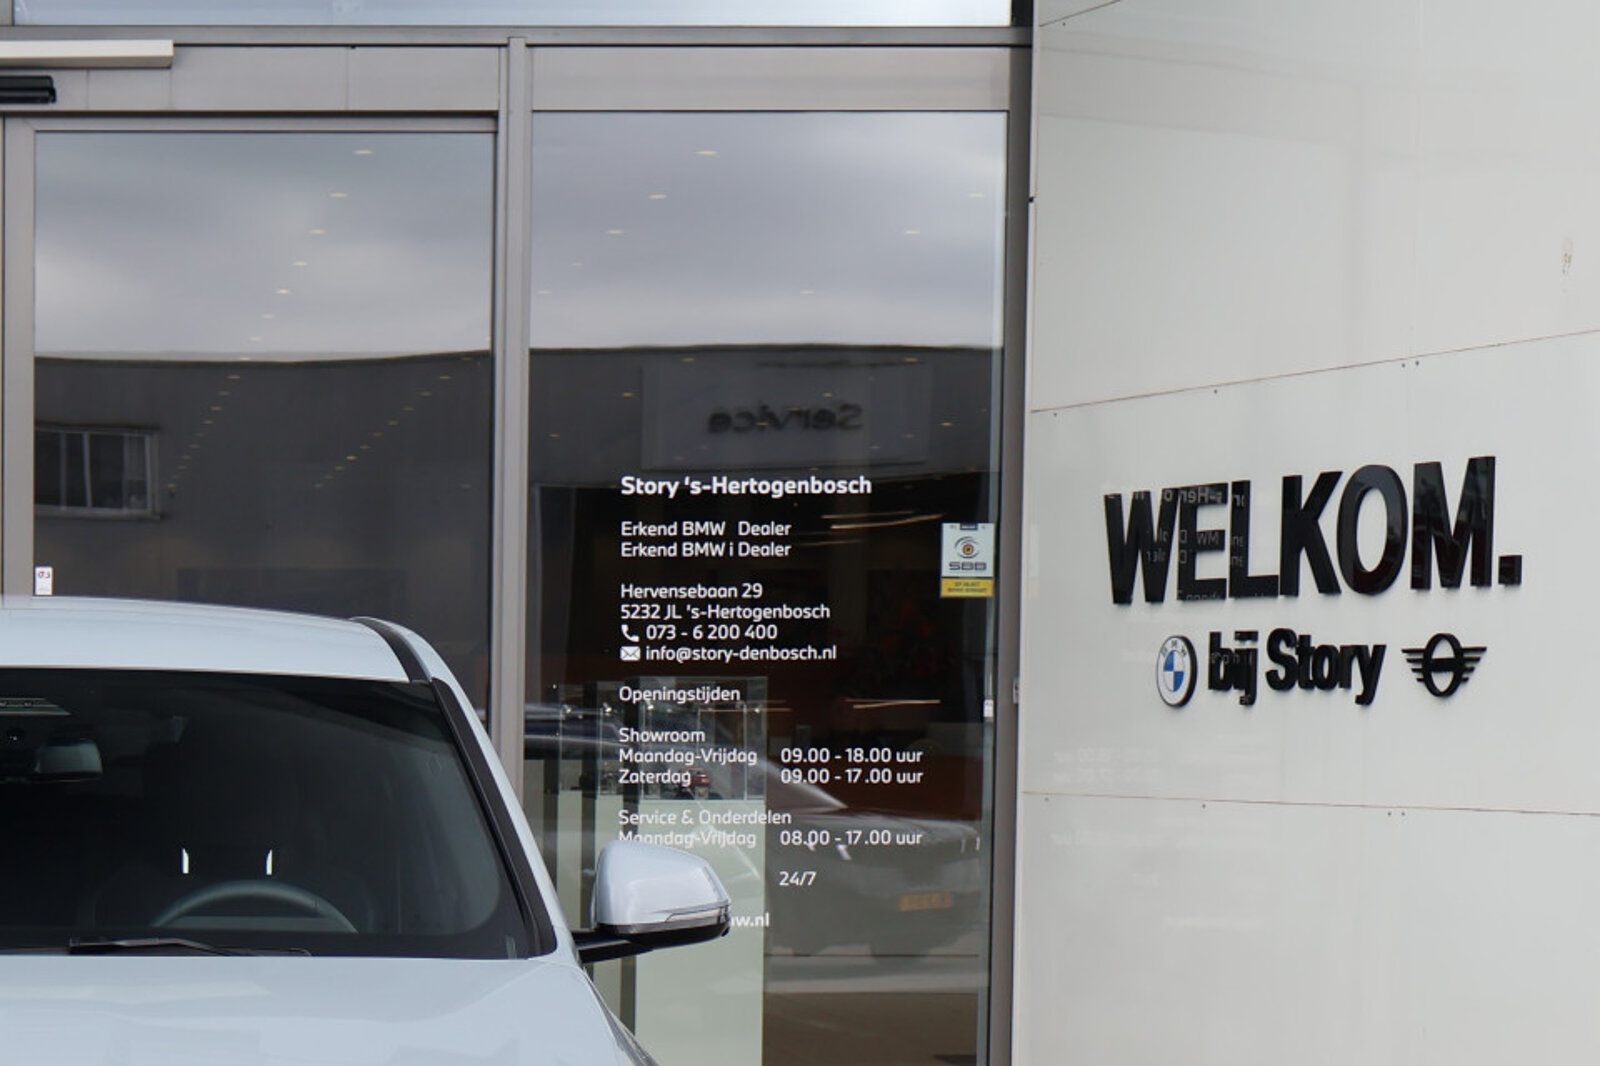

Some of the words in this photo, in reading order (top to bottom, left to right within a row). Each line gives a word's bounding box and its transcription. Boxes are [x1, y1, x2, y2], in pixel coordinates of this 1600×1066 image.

[622, 476, 679, 498] Story
[622, 521, 677, 536] Erkend
[683, 521, 725, 535] BMW
[738, 521, 791, 535] Dealer
[1104, 456, 1522, 604] WELKOM.
[621, 542, 677, 557] Erkend
[683, 542, 725, 557] BMW
[738, 542, 791, 557] Dealer
[621, 584, 737, 598] Hervensebaan
[742, 583, 762, 598] 29
[621, 604, 660, 619] 5232
[664, 604, 682, 620] JL
[646, 625, 676, 640] 073
[693, 625, 703, 639] 6
[708, 624, 740, 639] 200
[745, 624, 777, 639] 400
[646, 645, 836, 663] info@story-denbosch.nl
[1208, 631, 1258, 705] bij
[1266, 627, 1386, 705] Story
[620, 686, 740, 705] Openingstijden
[619, 728, 705, 742] Showroom
[620, 748, 758, 766] Maandag-Vrijdag
[781, 748, 830, 763] 09.00
[846, 748, 891, 762] 18.00
[896, 752, 923, 762] uur
[619, 768, 691, 787] Zaterdag
[782, 768, 831, 785] 09.00
[897, 773, 923, 783] uur
[619, 810, 677, 825] Service
[681, 810, 694, 824] &
[699, 809, 790, 826] Onderdelen
[781, 830, 831, 847] 08.00
[896, 834, 923, 844] uur
[779, 871, 816, 886] 24/7
